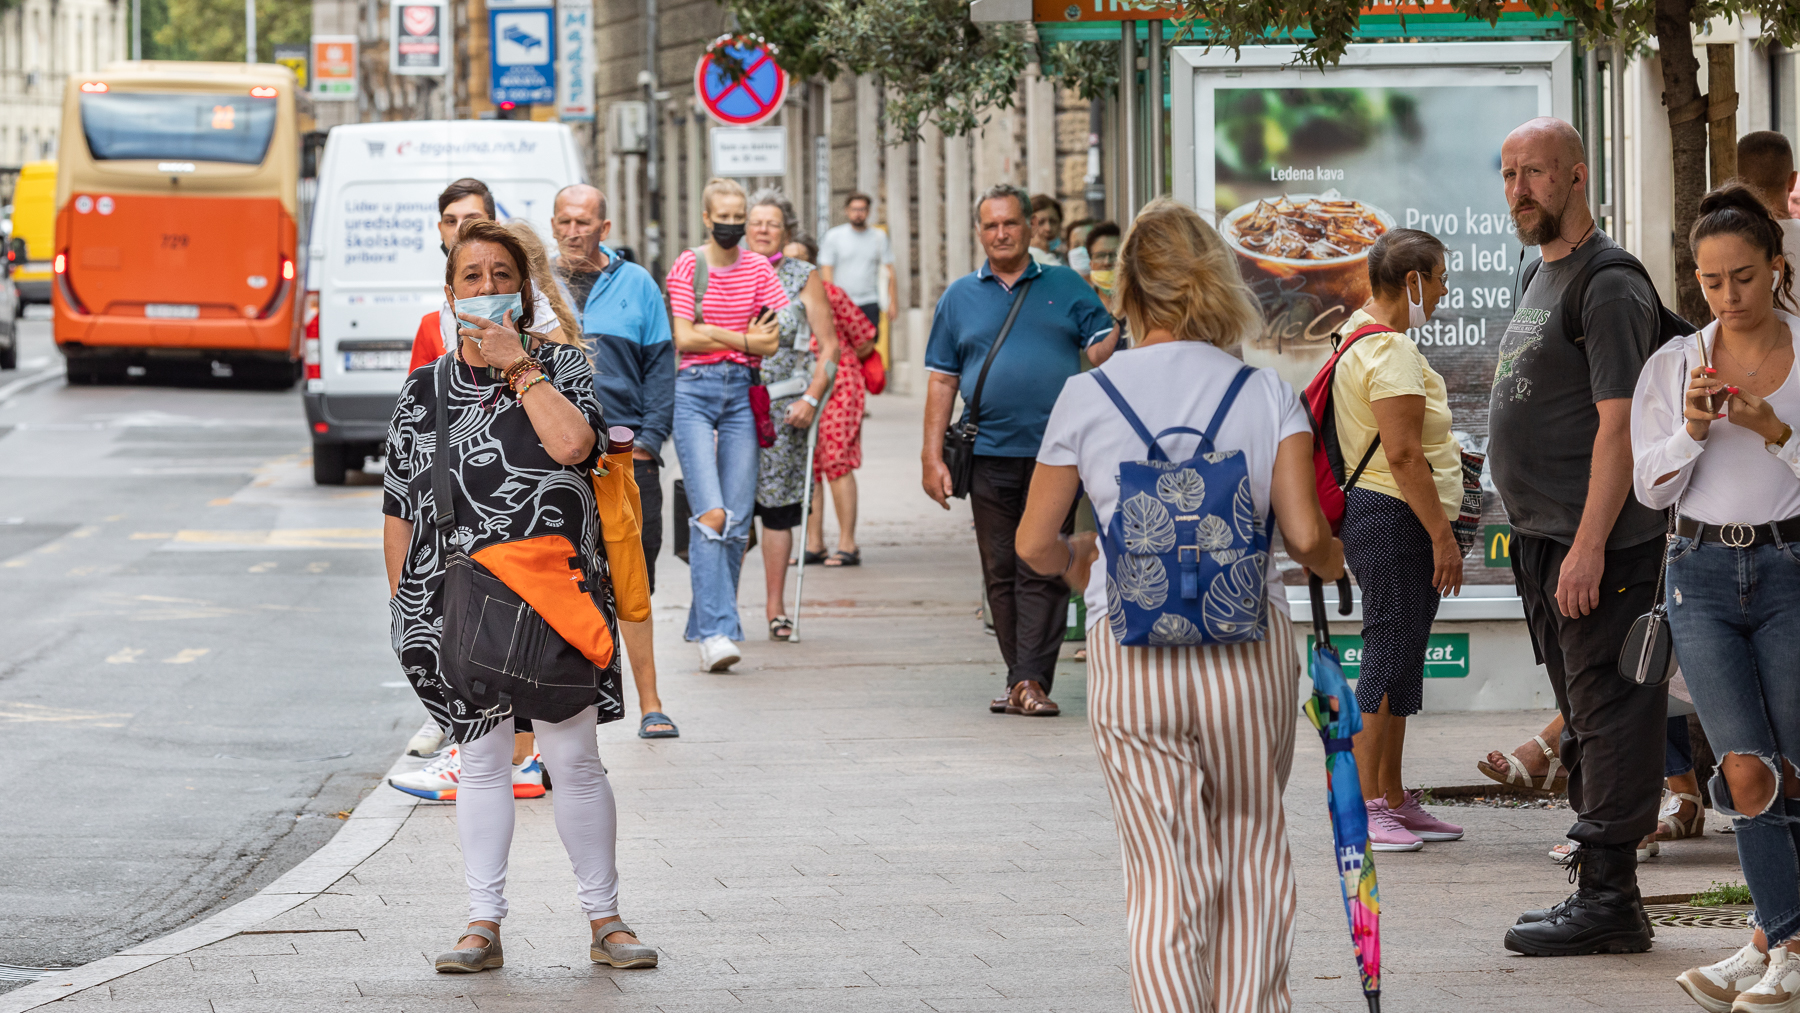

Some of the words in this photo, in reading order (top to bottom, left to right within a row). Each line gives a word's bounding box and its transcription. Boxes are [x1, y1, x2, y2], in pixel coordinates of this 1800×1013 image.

[1271, 165, 1314, 181] Ledena
[1316, 165, 1344, 181] kava
[345, 216, 424, 232] uredskog
[1406, 208, 1459, 235] Prvo
[1471, 243, 1514, 275] led,
[1471, 287, 1511, 309] sve
[1512, 308, 1551, 325] YPRUS
[1405, 317, 1486, 347] ostalo!
